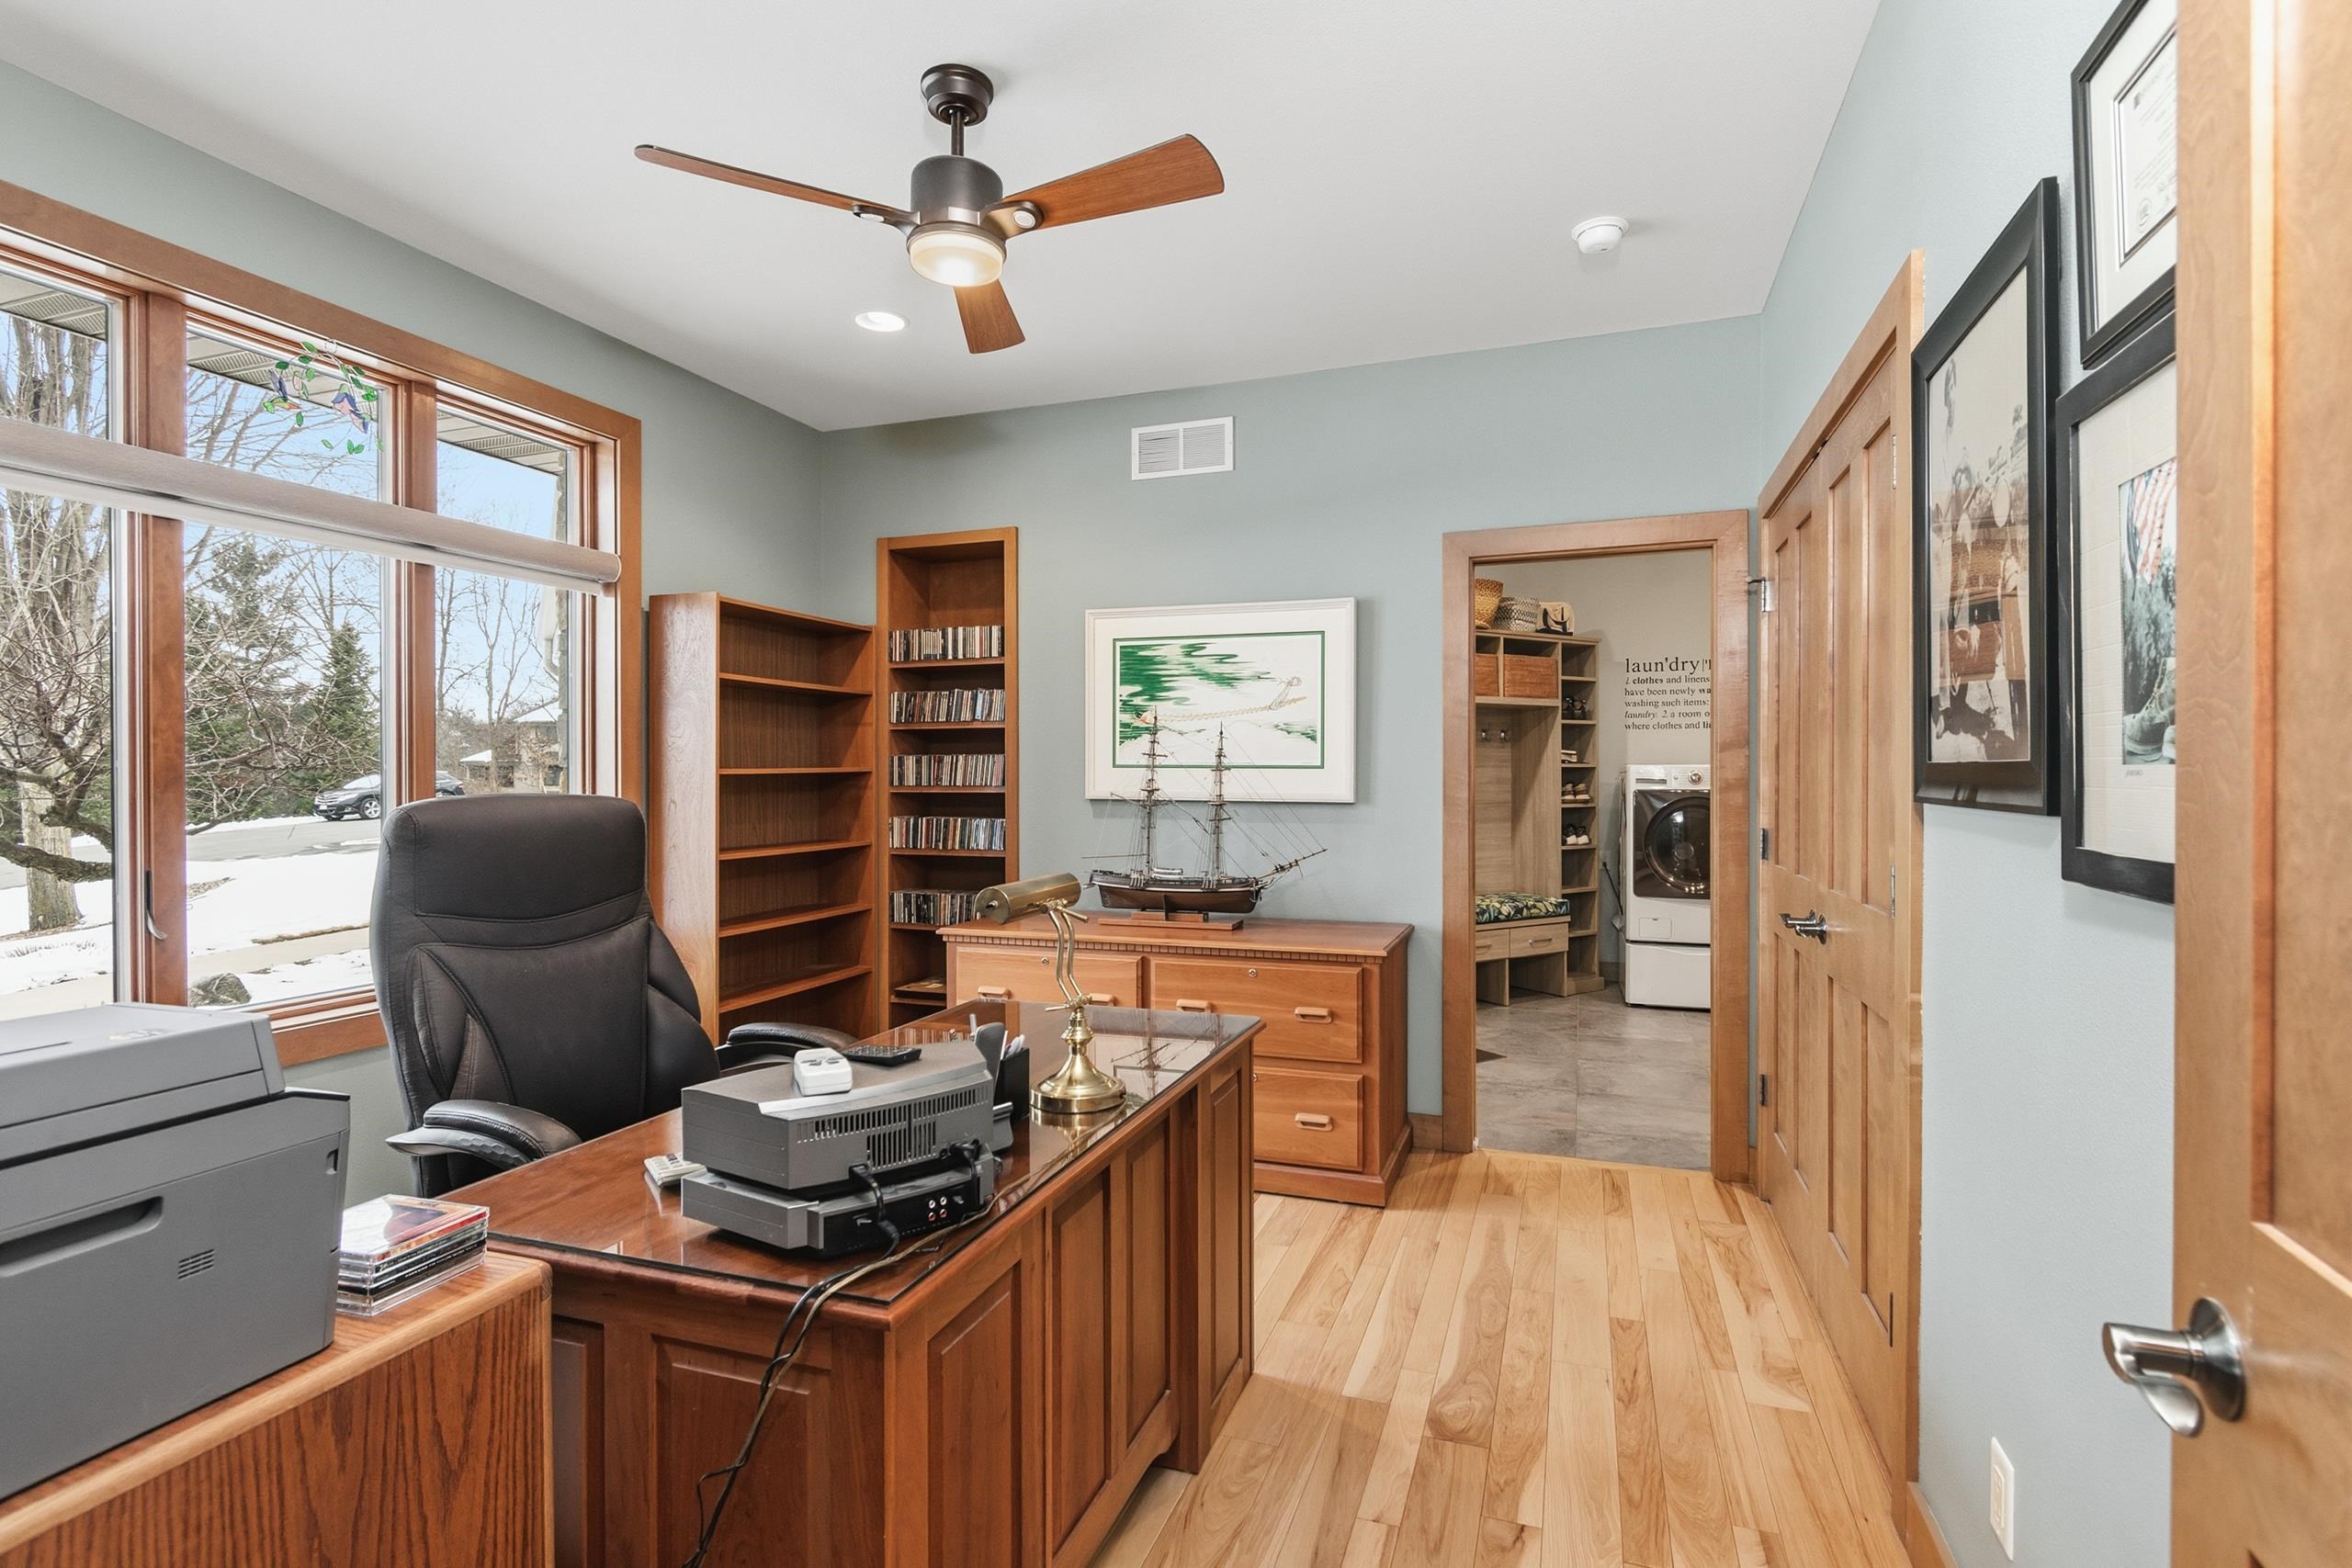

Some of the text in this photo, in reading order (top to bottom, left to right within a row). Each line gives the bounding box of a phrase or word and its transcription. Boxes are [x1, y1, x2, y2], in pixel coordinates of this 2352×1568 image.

[1625, 657, 1700, 675] laun'dry
[1632, 676, 1664, 684] clothes
[1666, 675, 1682, 684] and
[1684, 675, 1710, 683] linens
[1624, 687, 1645, 696] have
[1646, 687, 1668, 695] been
[1669, 686, 1696, 696] newly
[1624, 699, 1659, 708] washing
[1661, 698, 1681, 707] such
[1624, 721, 1651, 730] where
[1652, 721, 1683, 730] clothes
[1684, 720, 1701, 730] and
